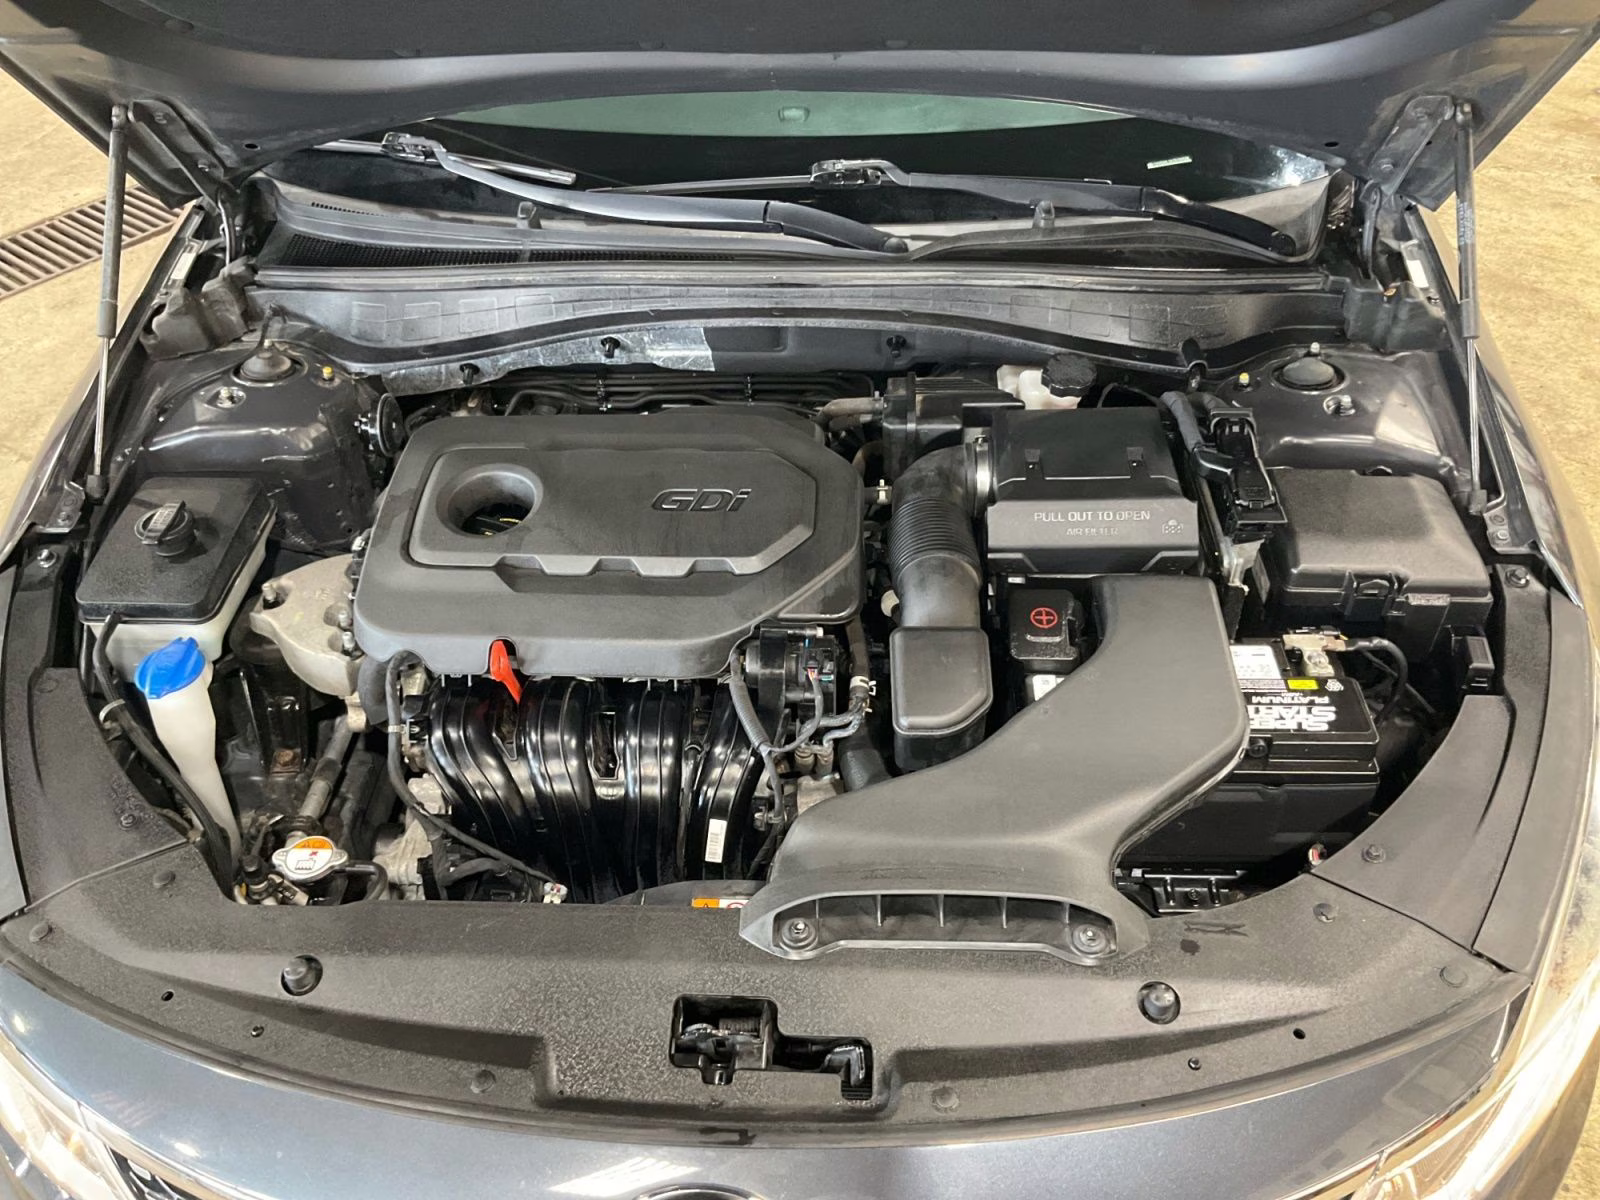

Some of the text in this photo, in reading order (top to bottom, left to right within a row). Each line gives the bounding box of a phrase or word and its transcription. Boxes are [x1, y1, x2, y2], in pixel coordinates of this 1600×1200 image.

[651, 487, 752, 512] GDi
[1034, 510, 1151, 522] PULL OUT TO OPEN
[1066, 527, 1119, 536] AIR FILTER
[1252, 695, 1330, 704] PLATINUM
